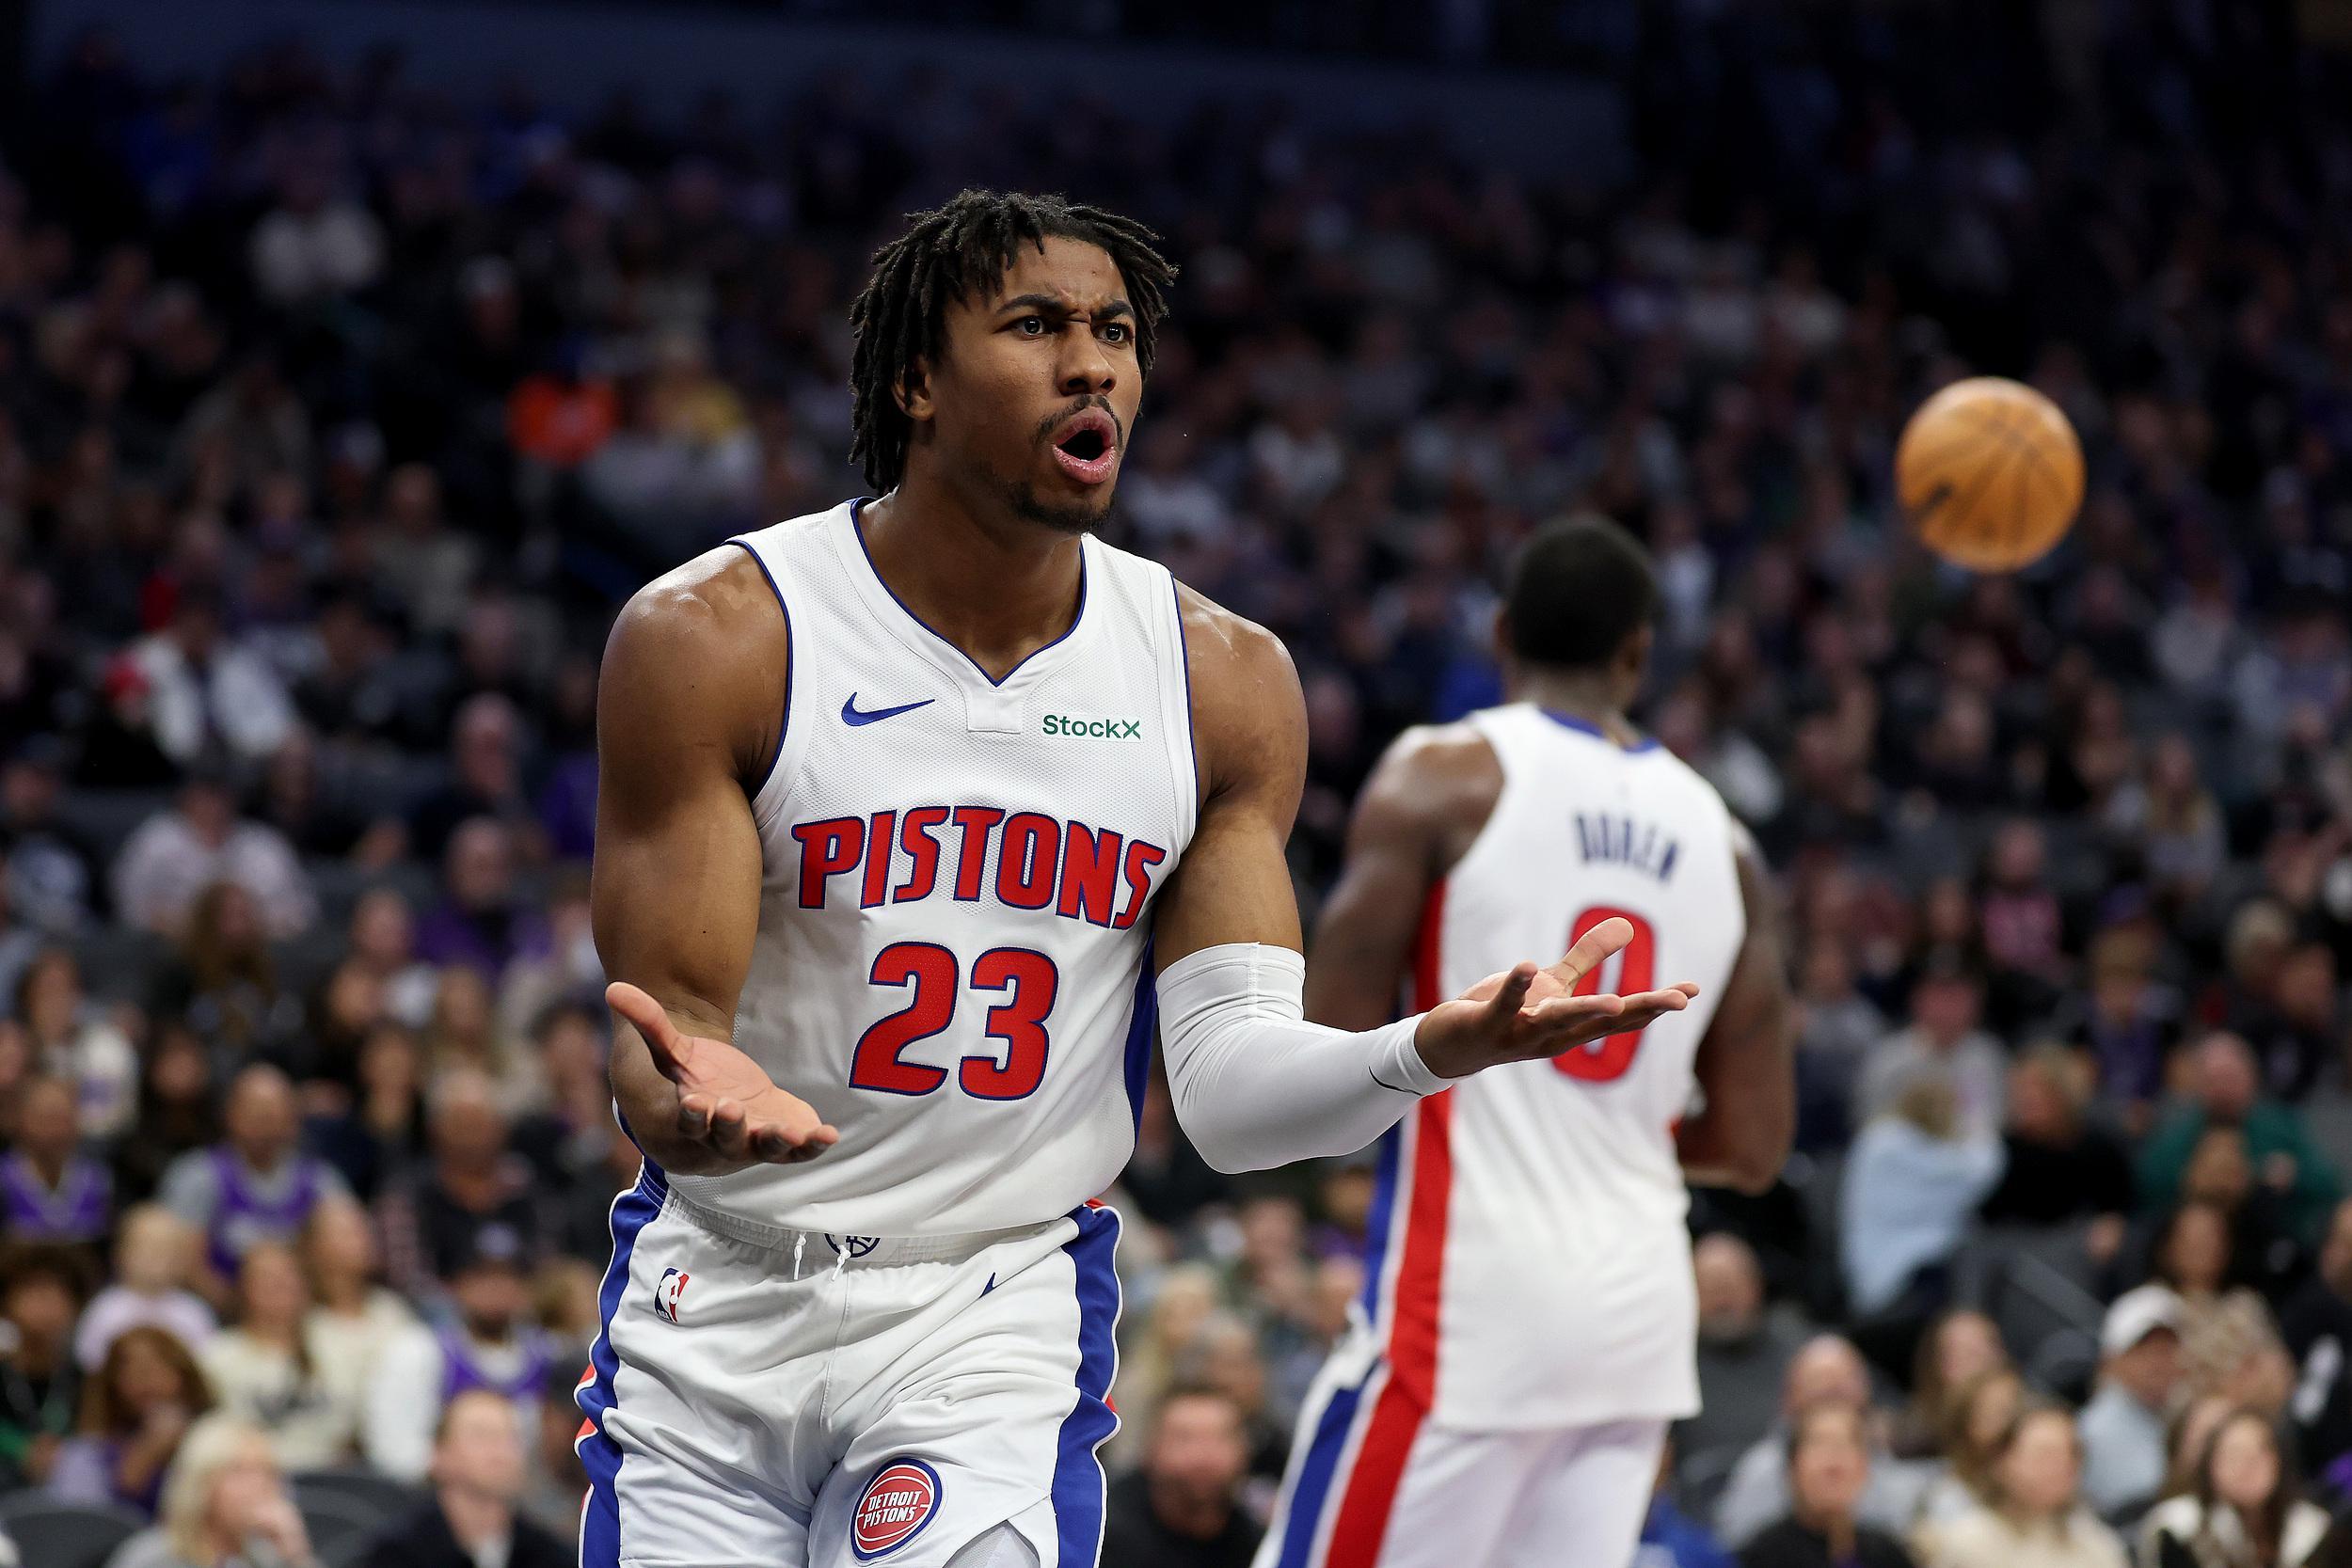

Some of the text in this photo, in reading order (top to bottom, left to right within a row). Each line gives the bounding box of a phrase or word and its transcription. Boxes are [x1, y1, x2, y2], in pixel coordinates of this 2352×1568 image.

[1042, 715, 1141, 740] StockX
[791, 805, 1167, 930] PISTONS
[849, 941, 1059, 1101] 23
[866, 1491, 923, 1512] DETROIT
[862, 1507, 918, 1529] PISTONS
